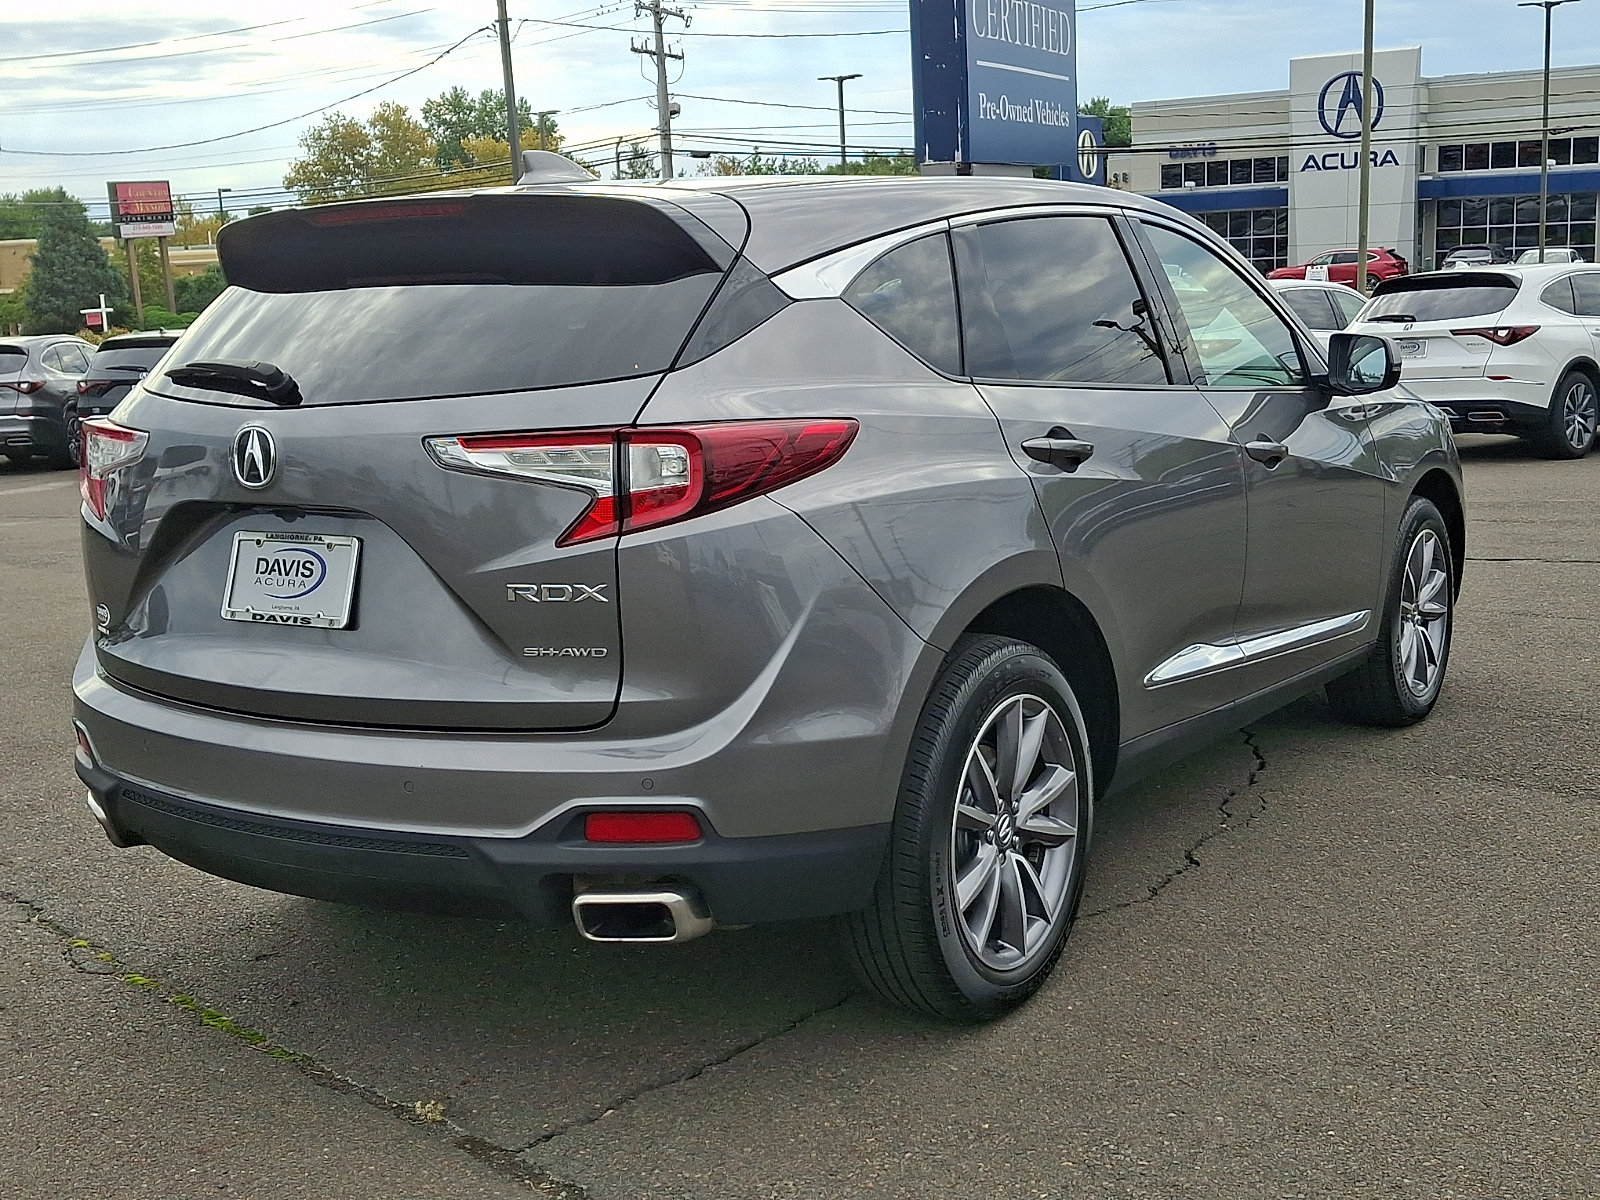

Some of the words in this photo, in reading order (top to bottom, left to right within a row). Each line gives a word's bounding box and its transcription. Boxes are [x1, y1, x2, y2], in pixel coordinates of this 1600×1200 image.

[972, 0, 1071, 56] CERTIFIED
[978, 92, 1034, 123] Pre-Owned
[1035, 99, 1070, 127] Vehicles
[1300, 149, 1400, 172] ACURA
[255, 557, 315, 579] DAVIS
[254, 577, 307, 589] ACURA
[506, 584, 609, 602] RDX
[251, 613, 312, 624] DAVIS
[523, 647, 608, 657] SH-AWD
